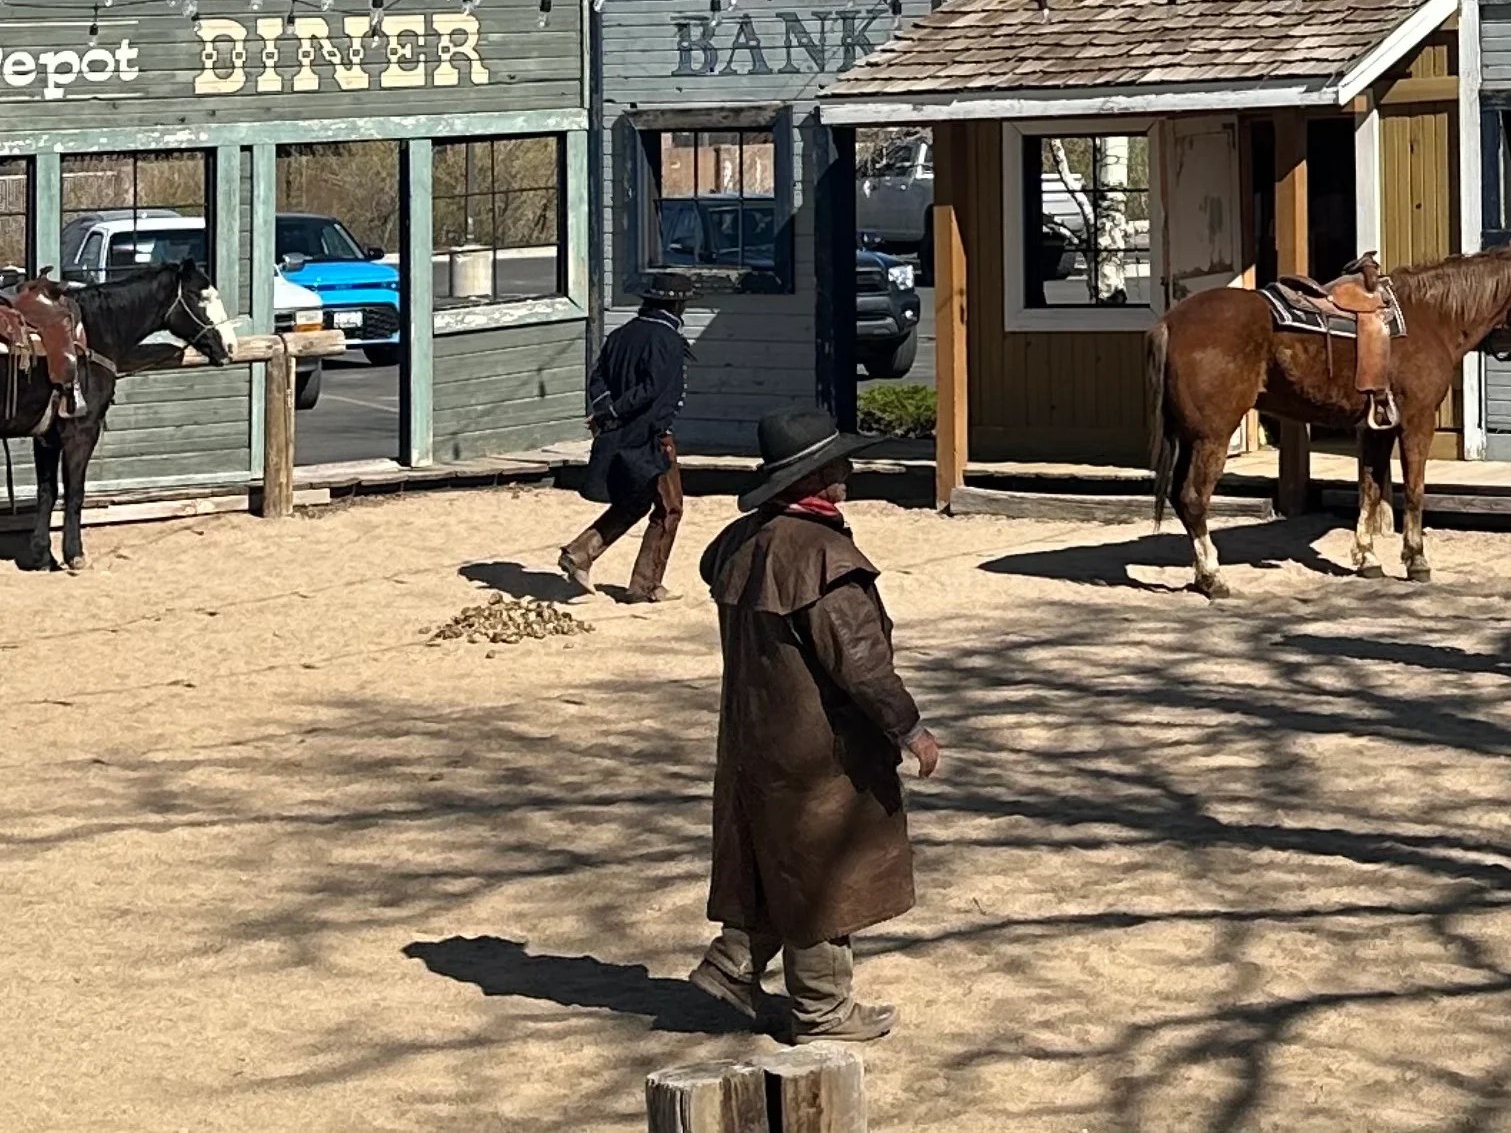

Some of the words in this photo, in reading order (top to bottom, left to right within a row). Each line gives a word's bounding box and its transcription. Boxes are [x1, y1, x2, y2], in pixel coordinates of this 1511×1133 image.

[0, 38, 140, 100] epot
[193, 13, 490, 95] DINER
[669, 10, 890, 76] BANK
